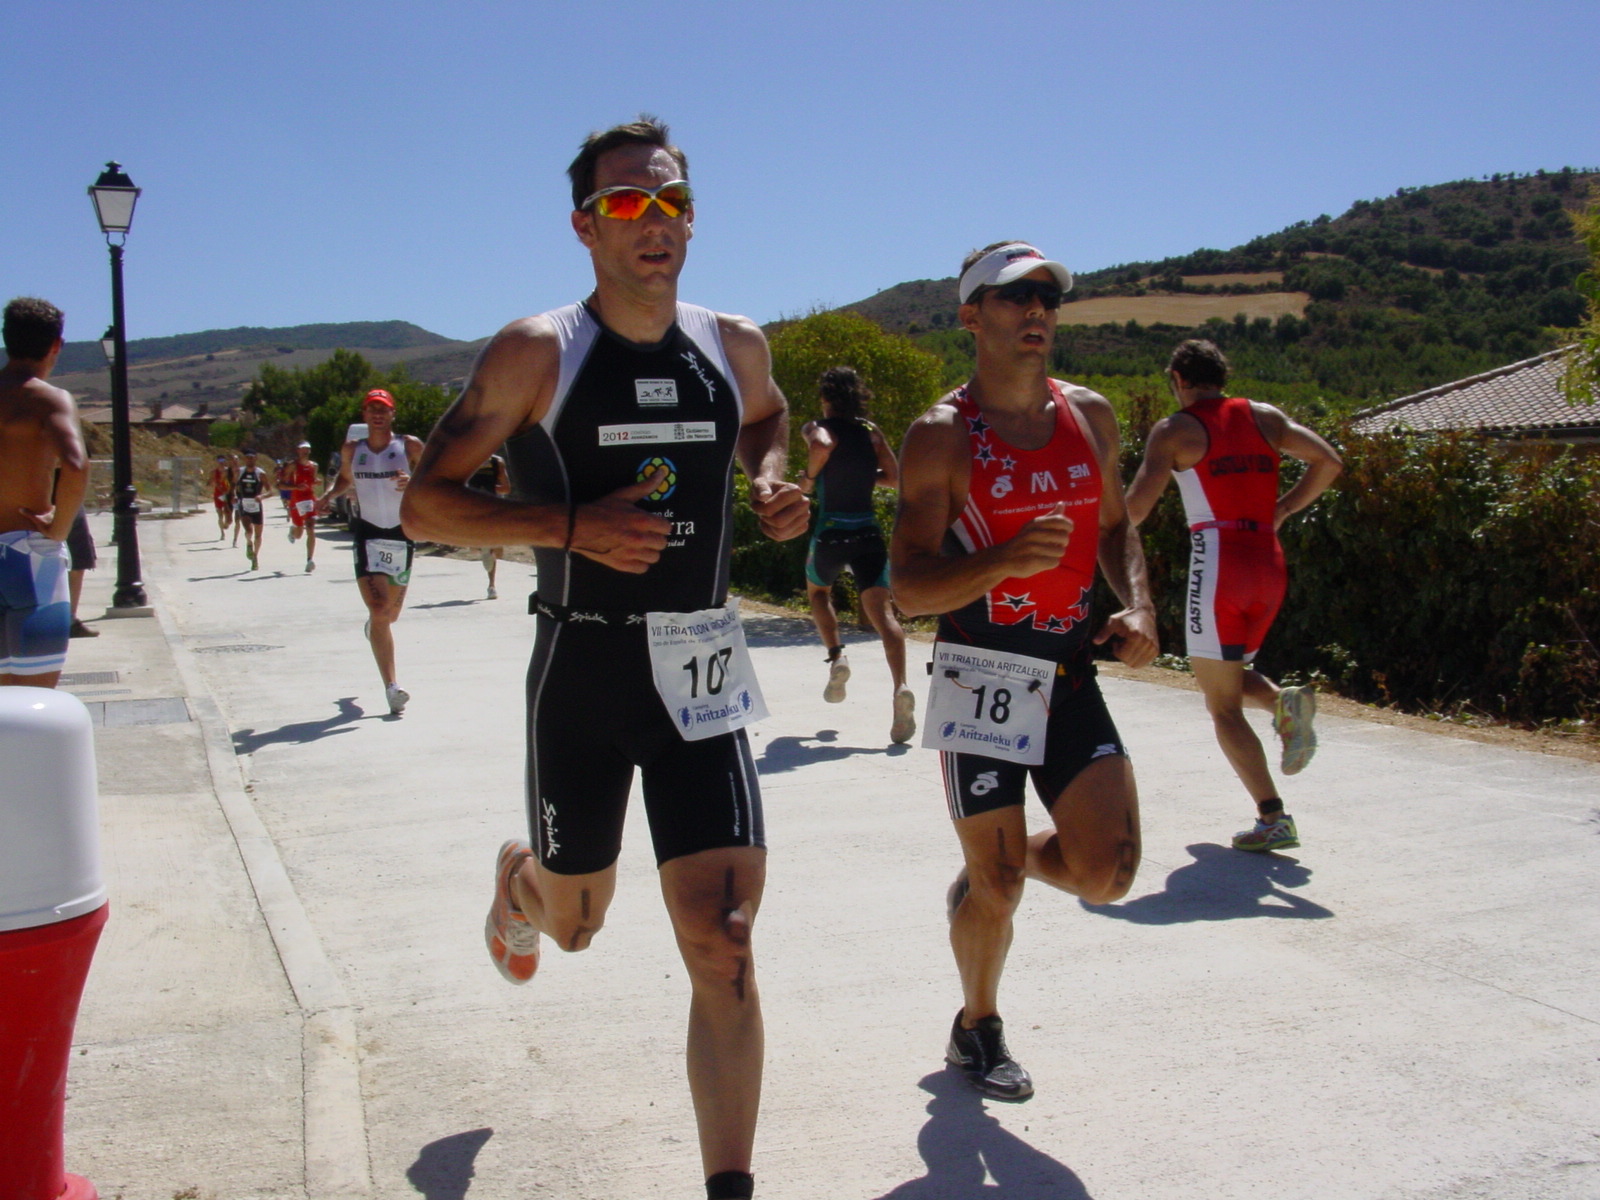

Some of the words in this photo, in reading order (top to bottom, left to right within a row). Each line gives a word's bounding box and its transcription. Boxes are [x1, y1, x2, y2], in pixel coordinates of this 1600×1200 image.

[602, 432, 629, 441] 2012
[664, 508, 674, 518] de
[379, 551, 393, 565] 28
[1193, 556, 1205, 566] Y
[1190, 568, 1203, 635] CASTILLA
[664, 623, 710, 636] TRIATLON
[683, 646, 732, 699] 107
[940, 652, 949, 661] VII
[951, 654, 995, 669] TRIATLON
[996, 662, 1050, 680] ARITZALEKU
[972, 684, 1012, 724] 18
[958, 728, 1011, 746] Aritzaleku
